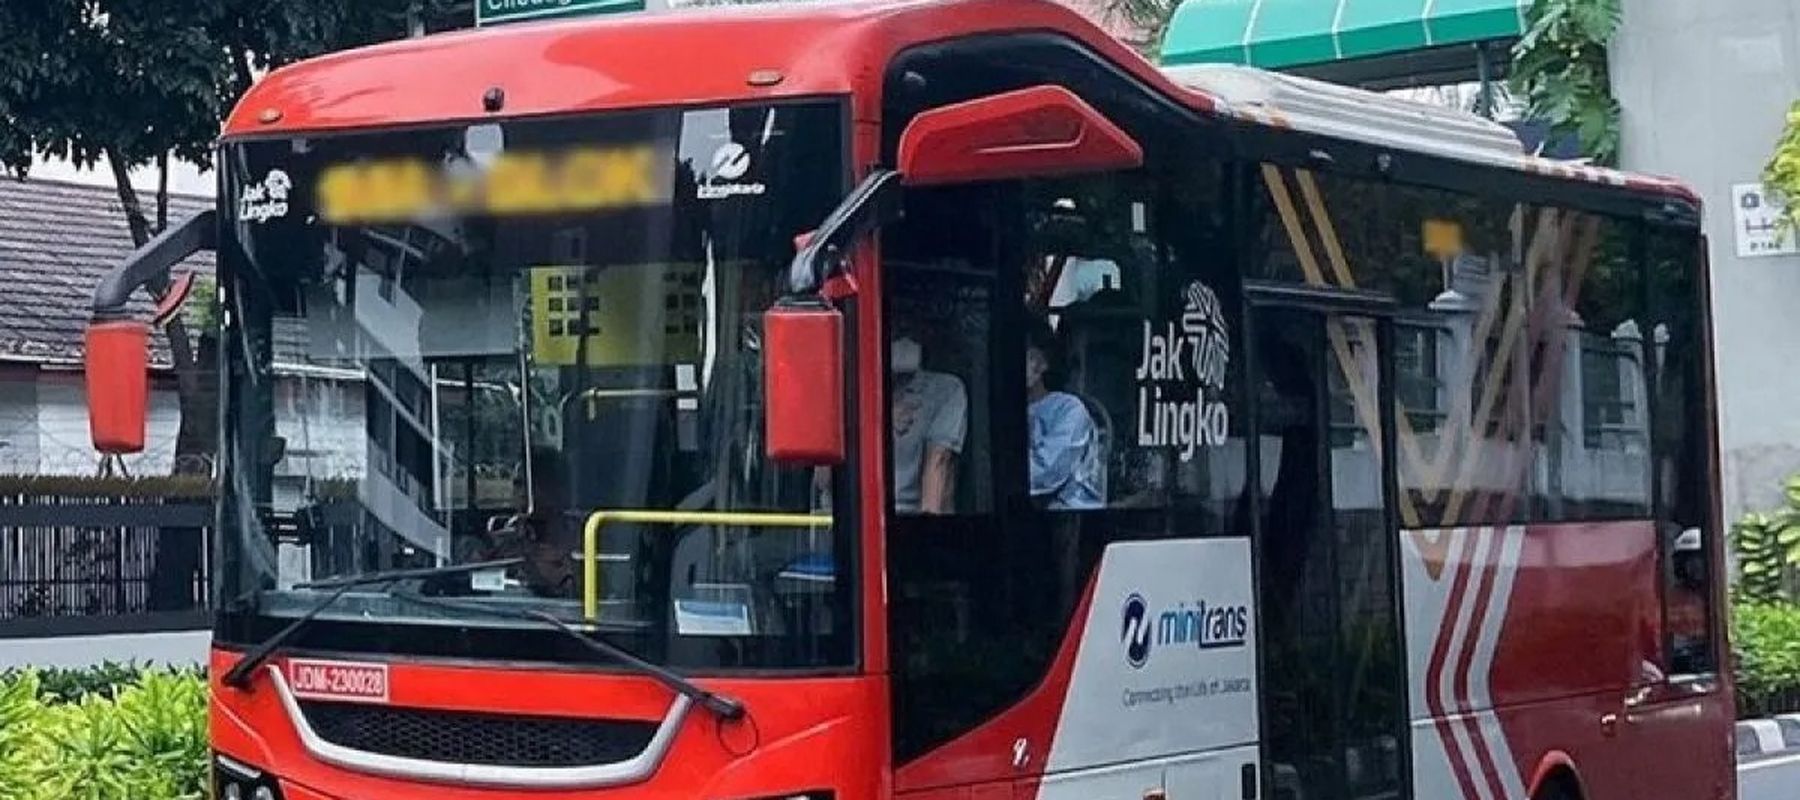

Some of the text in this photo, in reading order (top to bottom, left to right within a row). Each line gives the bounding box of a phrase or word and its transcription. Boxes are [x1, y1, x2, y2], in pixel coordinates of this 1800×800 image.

[240, 182, 266, 202] Jak
[240, 200, 288, 224] Lingko
[1136, 319, 1184, 380] Jak
[1138, 386, 1229, 463] Lingko
[1158, 599, 1247, 649] minitrans
[296, 666, 383, 695] JDM-230028
